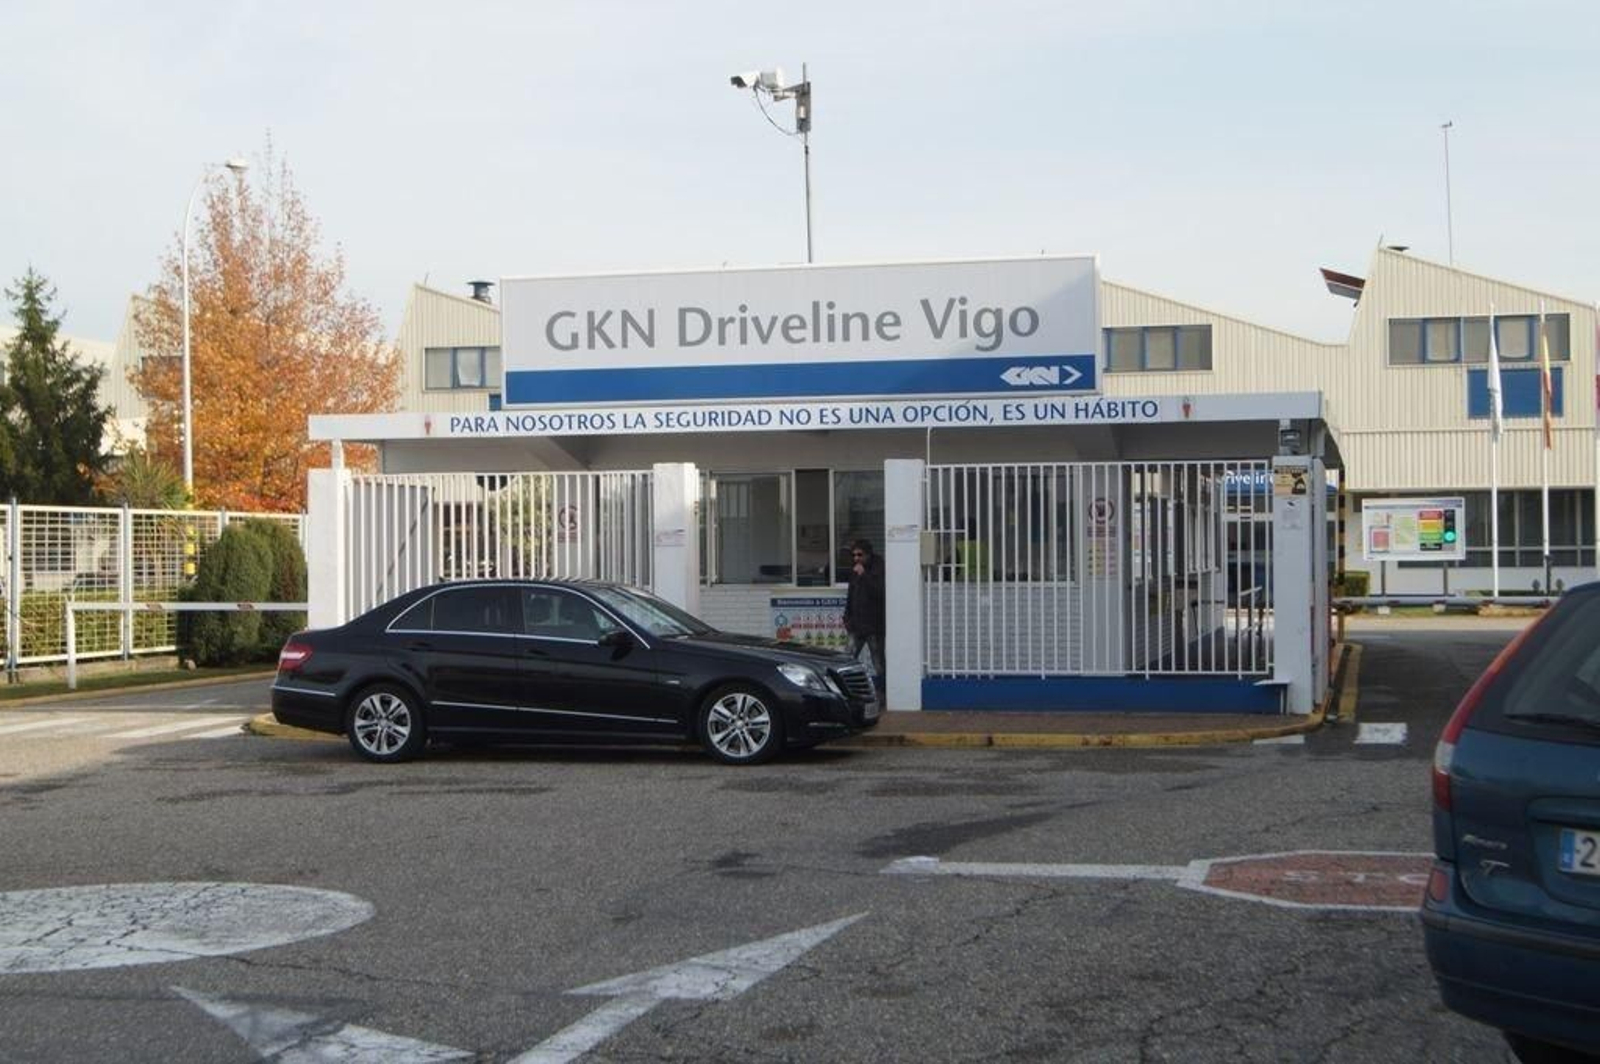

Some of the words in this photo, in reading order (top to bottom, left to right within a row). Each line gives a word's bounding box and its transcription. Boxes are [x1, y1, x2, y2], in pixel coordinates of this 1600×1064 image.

[545, 308, 656, 351] GKN
[677, 300, 901, 347] Driveline
[920, 296, 1040, 352] Vigo
[450, 415, 499, 433] PARA
[506, 413, 616, 432] NOSOTROS
[623, 412, 647, 430] LA
[654, 409, 772, 428] SEGURIDAD
[780, 408, 811, 425] NO
[819, 407, 841, 424] ES
[850, 406, 895, 424] UNA
[903, 400, 994, 424] OPCIÓN,
[1003, 403, 1025, 421] ES
[1034, 402, 1065, 420] UN
[1075, 398, 1158, 419] HÁBITO
